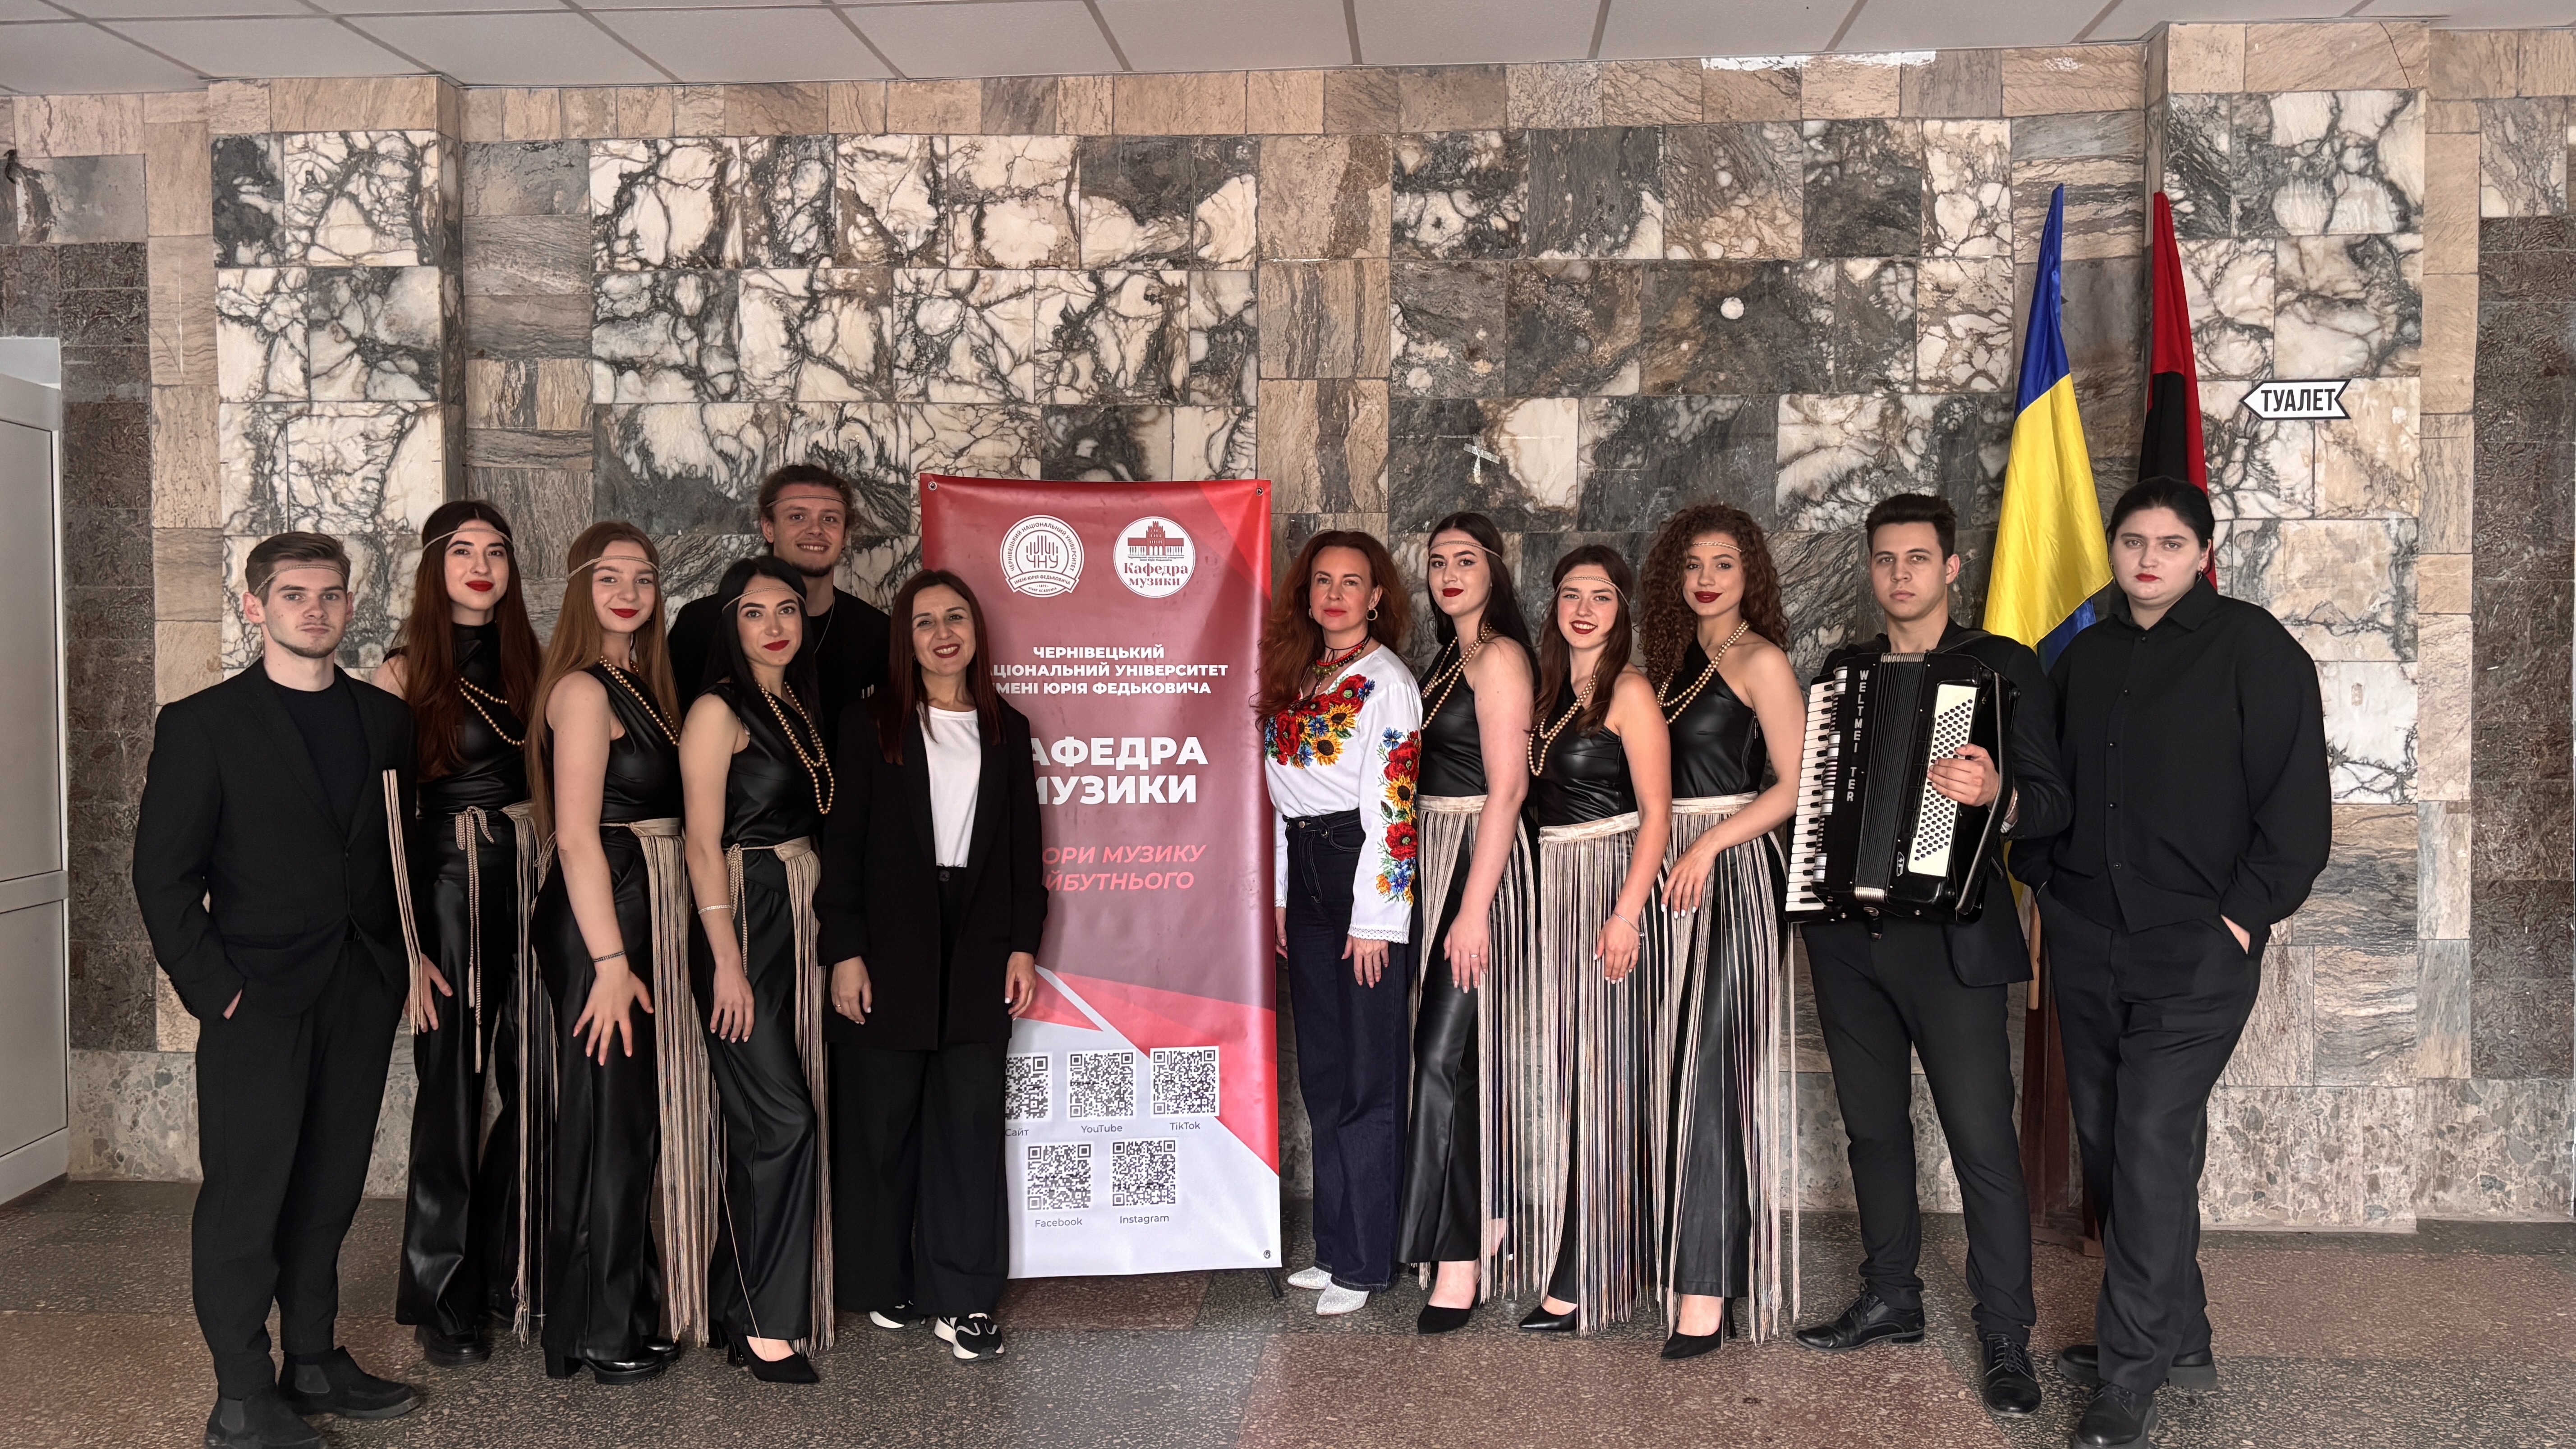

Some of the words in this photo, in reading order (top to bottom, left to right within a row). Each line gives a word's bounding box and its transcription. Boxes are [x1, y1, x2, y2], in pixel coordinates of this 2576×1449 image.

[2260, 388, 2336, 412] ТУАЛЕТ
[1007, 530, 1022, 571] ЧЕРНІВЕЦЬКИЙ
[1021, 522, 1067, 537] НАЦІОНАЛЬНИЙ
[1065, 534, 1077, 572] УНІВЕРСИТЕТ
[1026, 554, 1058, 569] ЧНУ
[1124, 562, 1188, 577] Кафедра
[1129, 578, 1180, 589] музики
[1033, 644, 1164, 660] ЧЕРНІВЕЦЬКИЙ
[990, 662, 1110, 678] ЦІОНАЛЬНИЙ
[1115, 664, 1228, 676] УНІВЕРСИТЕТ
[993, 682, 1038, 694] МЕНІ
[1044, 682, 1088, 695] ЮРІЯ
[1092, 682, 1212, 696] ФЕДЬКОВИЧА
[1031, 736, 1209, 770] АФЕДРА
[1042, 846, 1096, 865] ОРИ
[1102, 844, 1207, 864] МУЗИКУ
[1045, 869, 1194, 892] ЙБУТНЬОГО
[1005, 1128, 1029, 1136] Сайт
[1081, 1124, 1123, 1133] YouTube
[1169, 1121, 1201, 1131] TikTok
[1035, 1217, 1083, 1228] Facebook
[1120, 1215, 1169, 1224] Instagram
